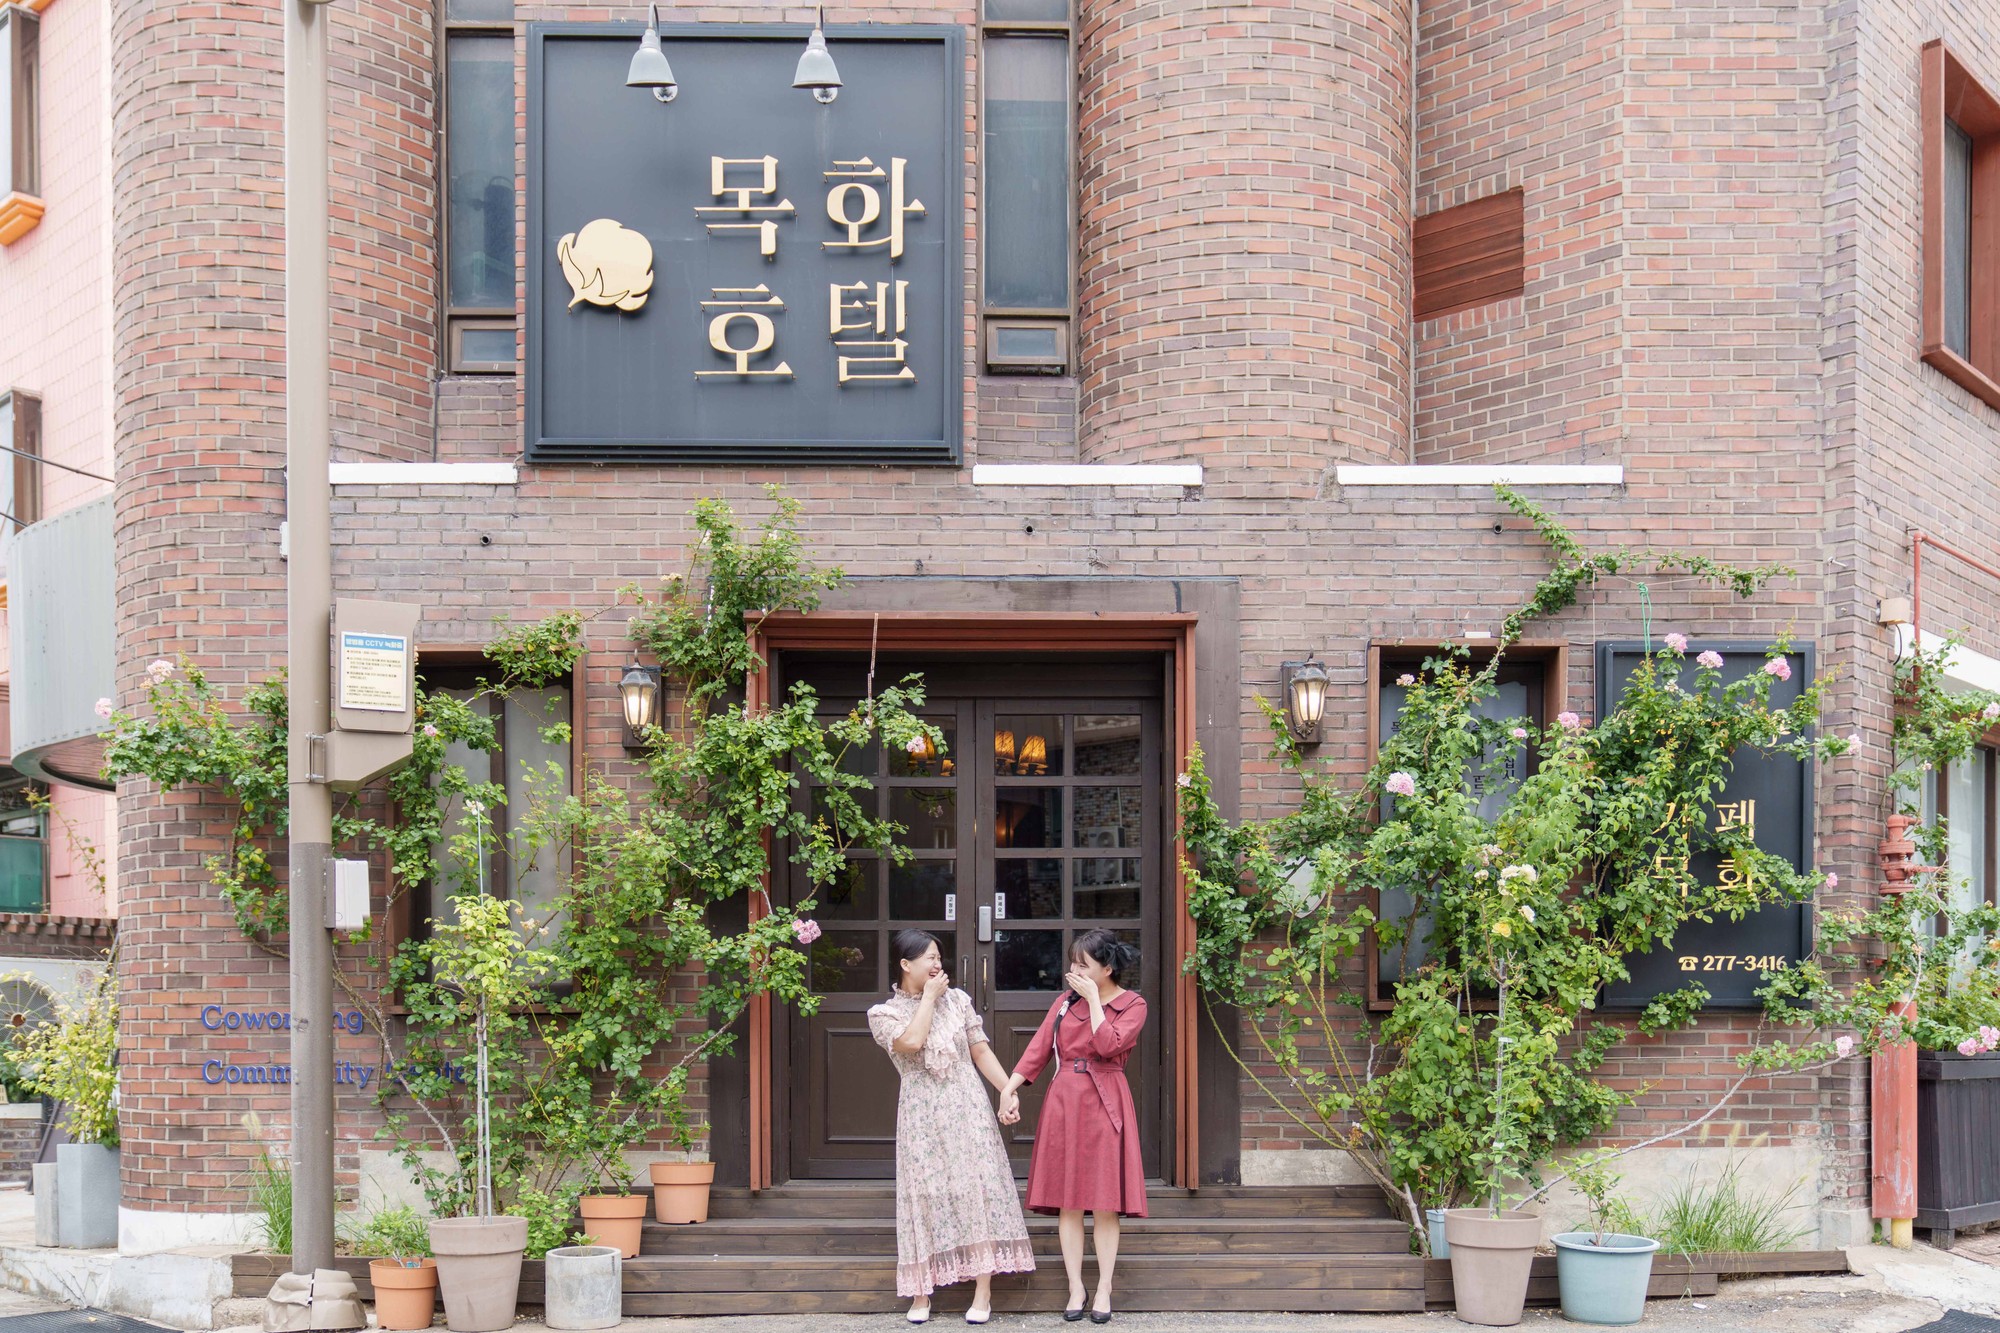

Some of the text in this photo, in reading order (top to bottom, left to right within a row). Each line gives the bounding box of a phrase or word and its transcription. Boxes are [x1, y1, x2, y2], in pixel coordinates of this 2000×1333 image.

[694, 154, 926, 258] 목화
[694, 280, 916, 382] 호텔
[1702, 954, 1788, 971] 277-3416
[201, 1004, 364, 1034] Coworng
[202, 1059, 374, 1089] Commity
